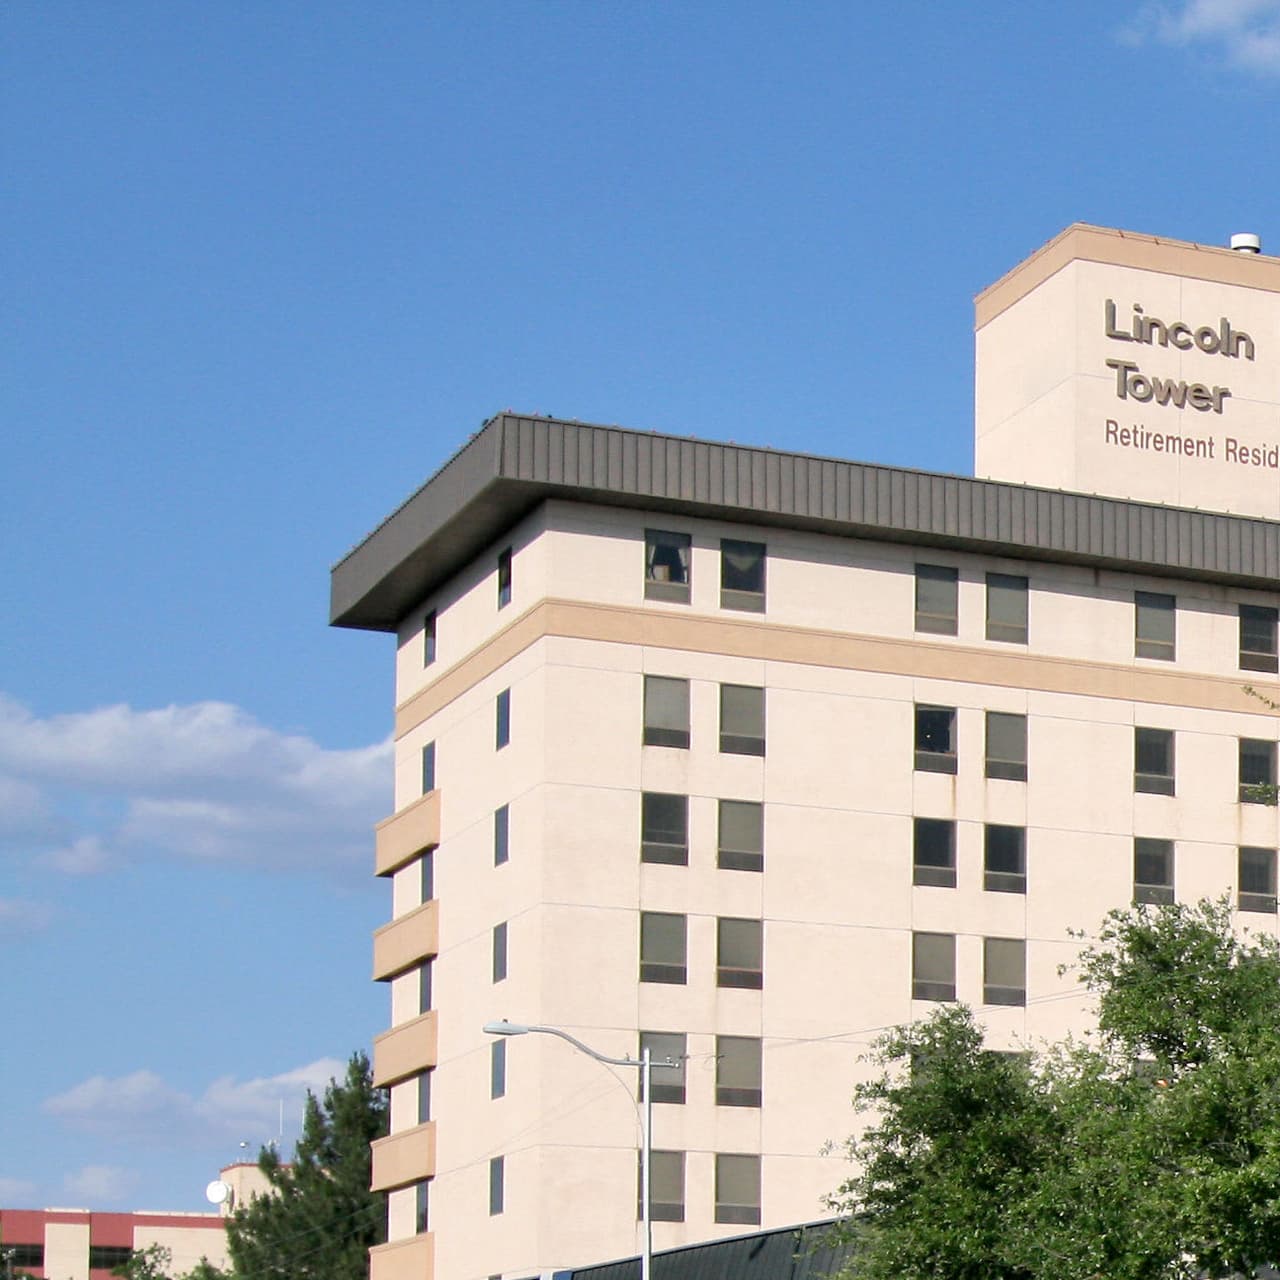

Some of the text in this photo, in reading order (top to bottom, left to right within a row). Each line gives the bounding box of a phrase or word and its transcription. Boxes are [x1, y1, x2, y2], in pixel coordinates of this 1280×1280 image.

[1105, 299, 1255, 361] Lincoln
[1106, 358, 1232, 414] Tower
[1105, 419, 1214, 459] Retirement
